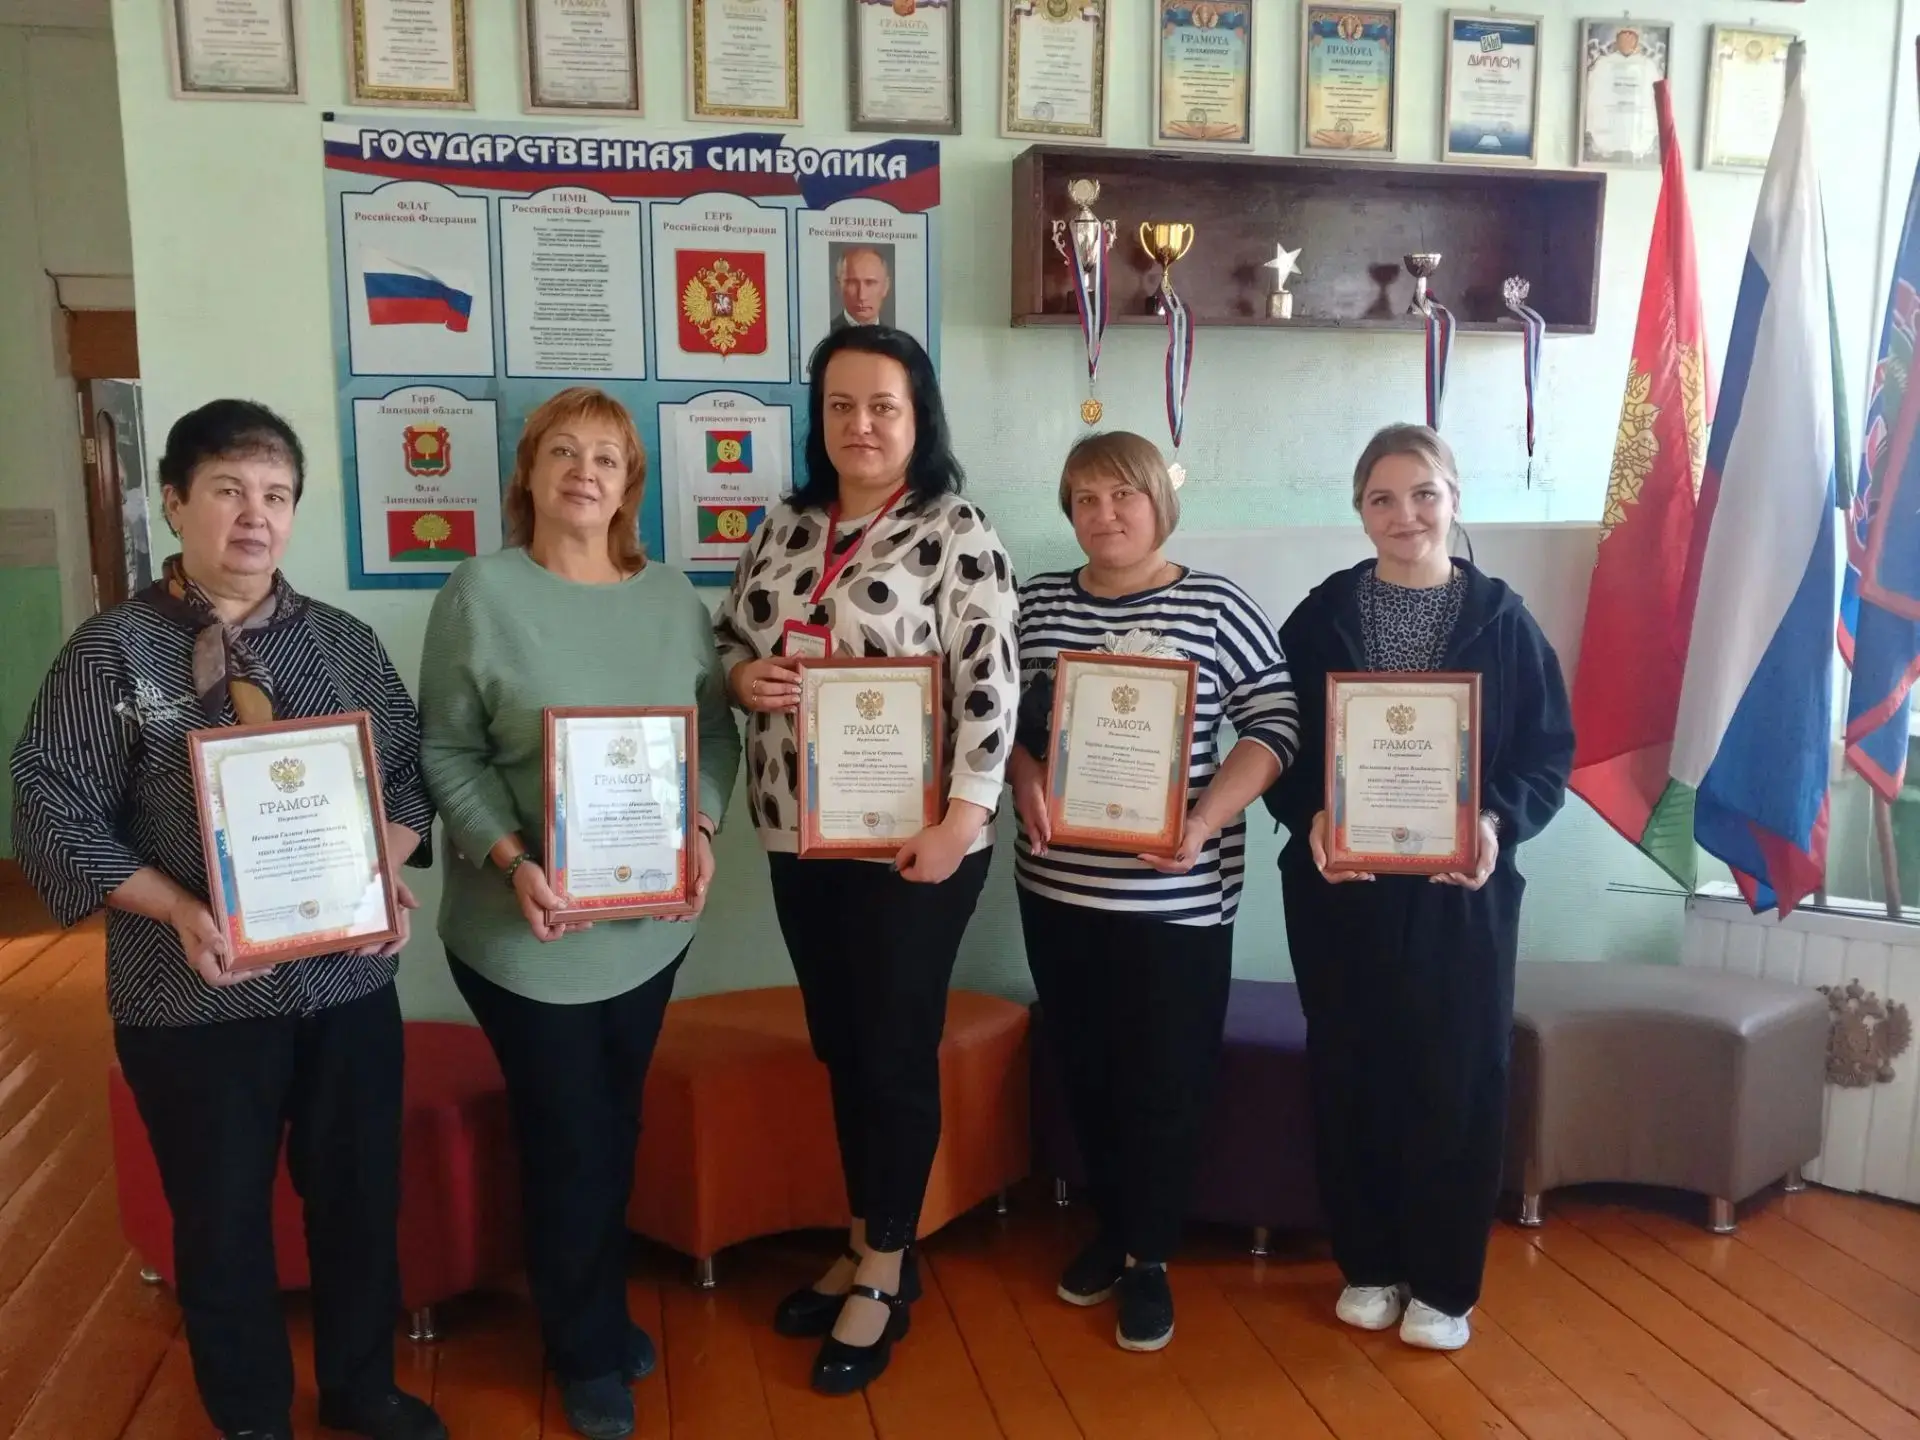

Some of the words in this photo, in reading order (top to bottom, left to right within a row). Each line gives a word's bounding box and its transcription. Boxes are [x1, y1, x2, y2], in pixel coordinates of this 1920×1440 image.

[1181, 33, 1229, 46] ГРАМОТА
[1327, 44, 1373, 57] ГРАМОТА
[1467, 54, 1521, 70] ДИПЛОМ
[359, 128, 693, 172] ГОСУДАРСТВЕННАЯ
[706, 146, 908, 181] СИМВОЛИКА
[552, 193, 587, 203] ГИМН
[397, 201, 430, 212] ФЛАГ
[512, 204, 571, 214] Российской
[573, 206, 631, 218] Федерации
[354, 212, 415, 224] Российской
[418, 213, 477, 227] Федерации
[704, 211, 733, 222] ГЕРБ
[829, 216, 894, 228] ПРЕЗИДЕНТ
[663, 222, 721, 233] Российской
[723, 223, 777, 236] Федерации
[808, 227, 863, 238] Российской
[865, 230, 918, 241] Федерации
[411, 394, 436, 404] Герб
[713, 399, 735, 409] Герб
[377, 406, 429, 415] Липецкой
[432, 406, 474, 415] области
[415, 483, 441, 493] Флаг
[382, 495, 434, 505] Липецкой
[437, 496, 478, 505] области
[843, 724, 900, 735] ГРАМОТА
[1096, 716, 1152, 731] ГРАМОТА
[1373, 739, 1433, 750] ГРАМОТА
[594, 773, 652, 786] ГРАМОТА
[259, 794, 330, 815] ГРАМОТА
